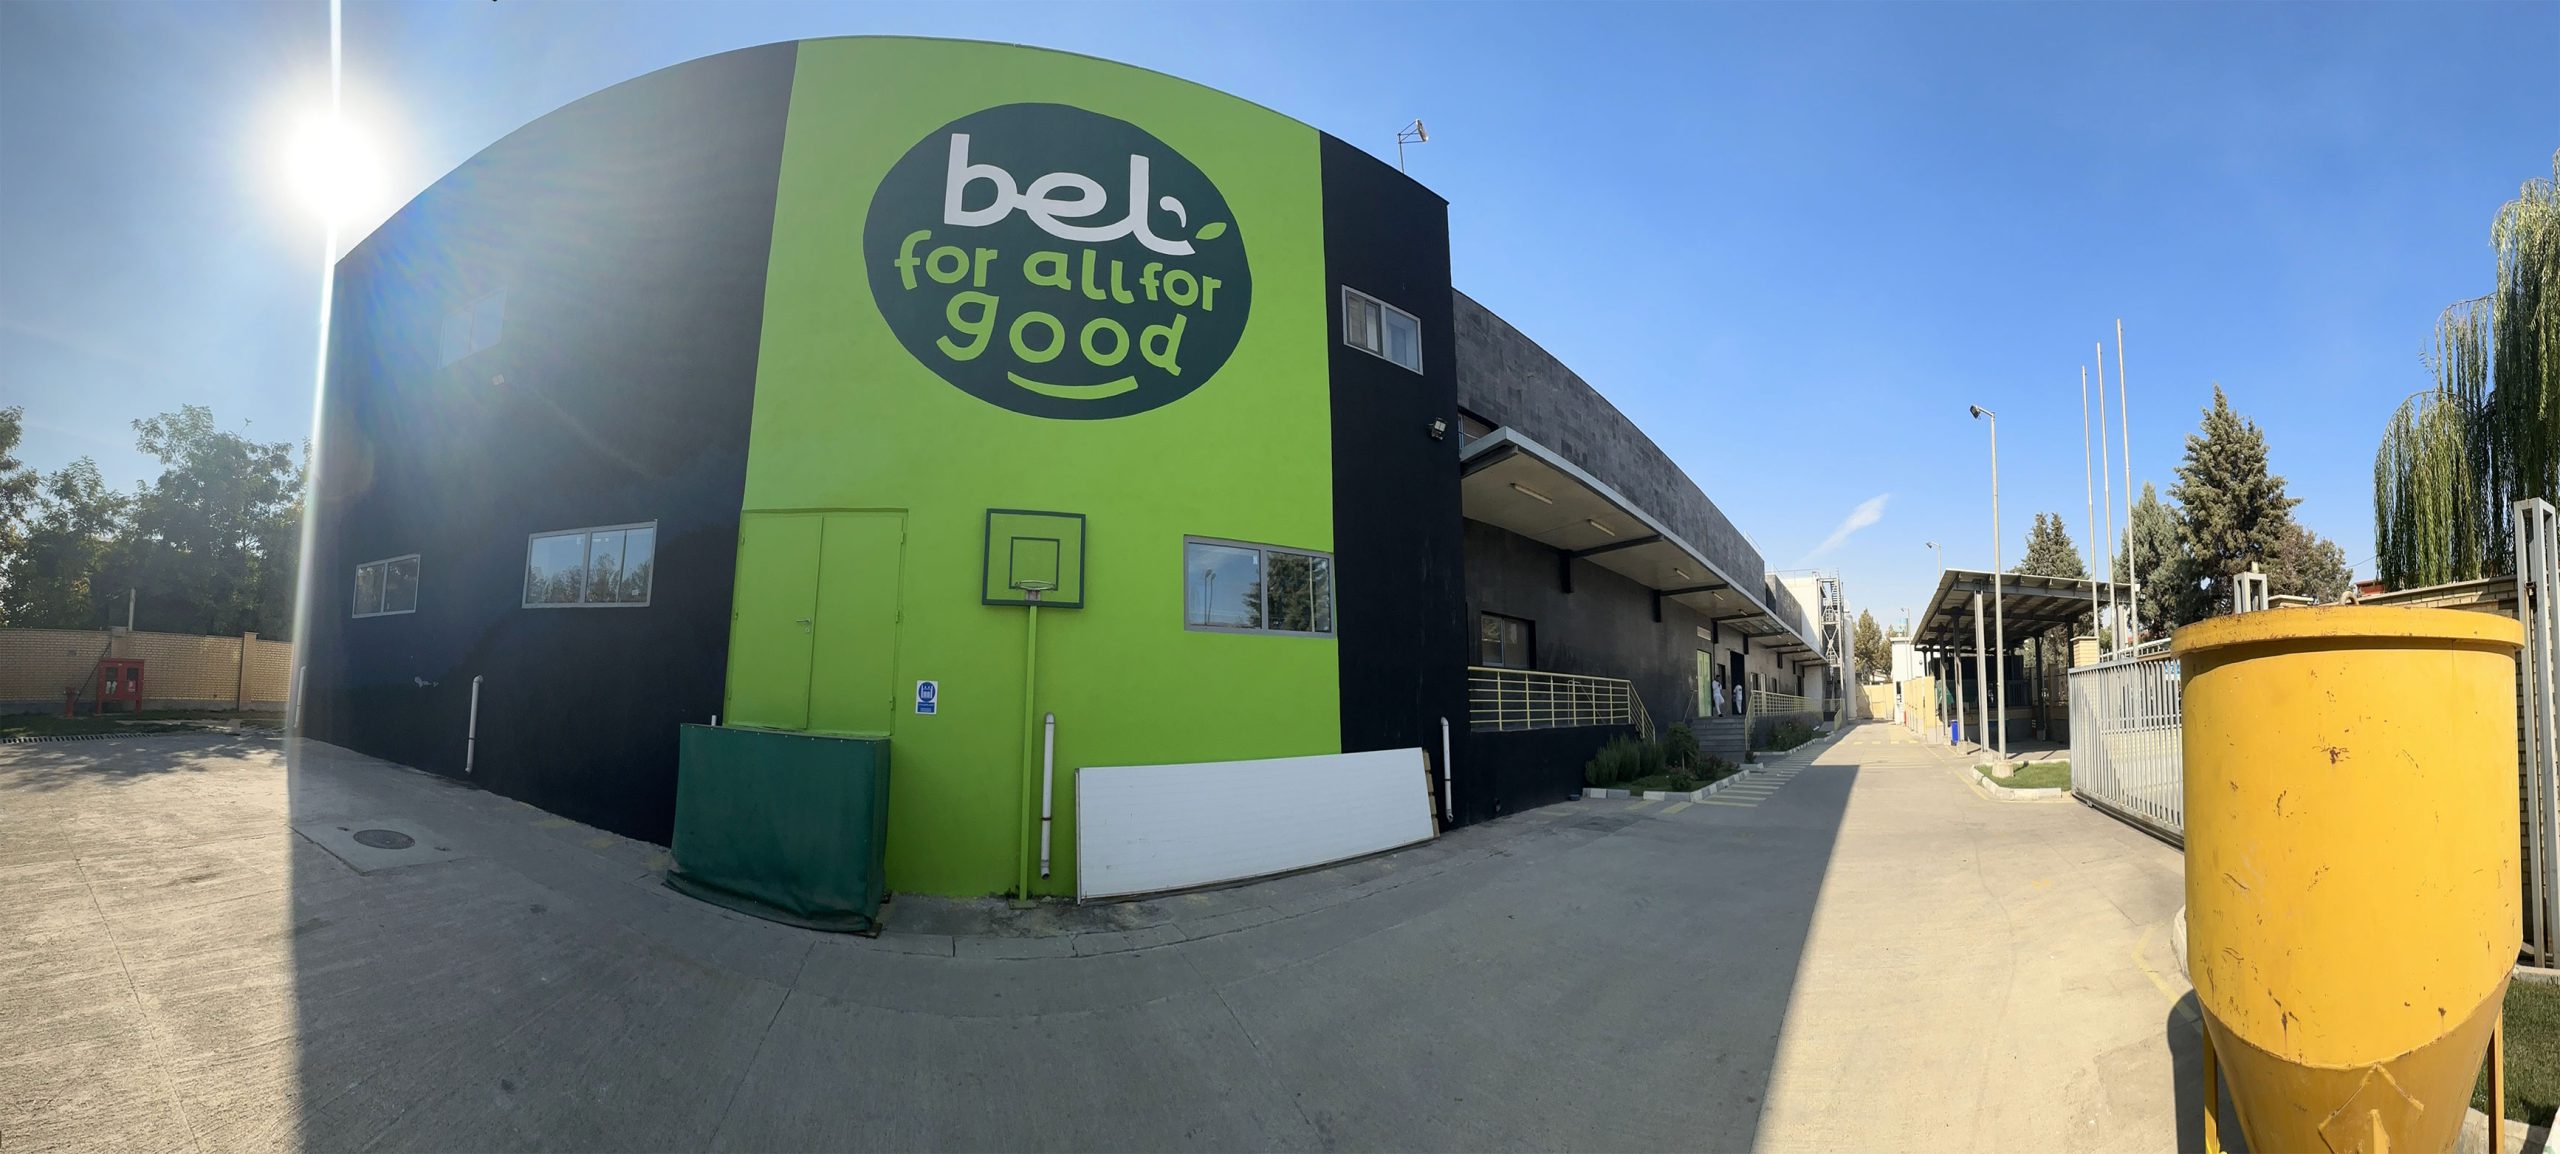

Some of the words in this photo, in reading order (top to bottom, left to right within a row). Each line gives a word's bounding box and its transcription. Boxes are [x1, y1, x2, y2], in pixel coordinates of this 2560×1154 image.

[943, 133, 1196, 256] bel
[894, 229, 999, 290] for
[1023, 249, 1135, 304] all
[1139, 263, 1222, 311] for
[936, 291, 1188, 376] good
